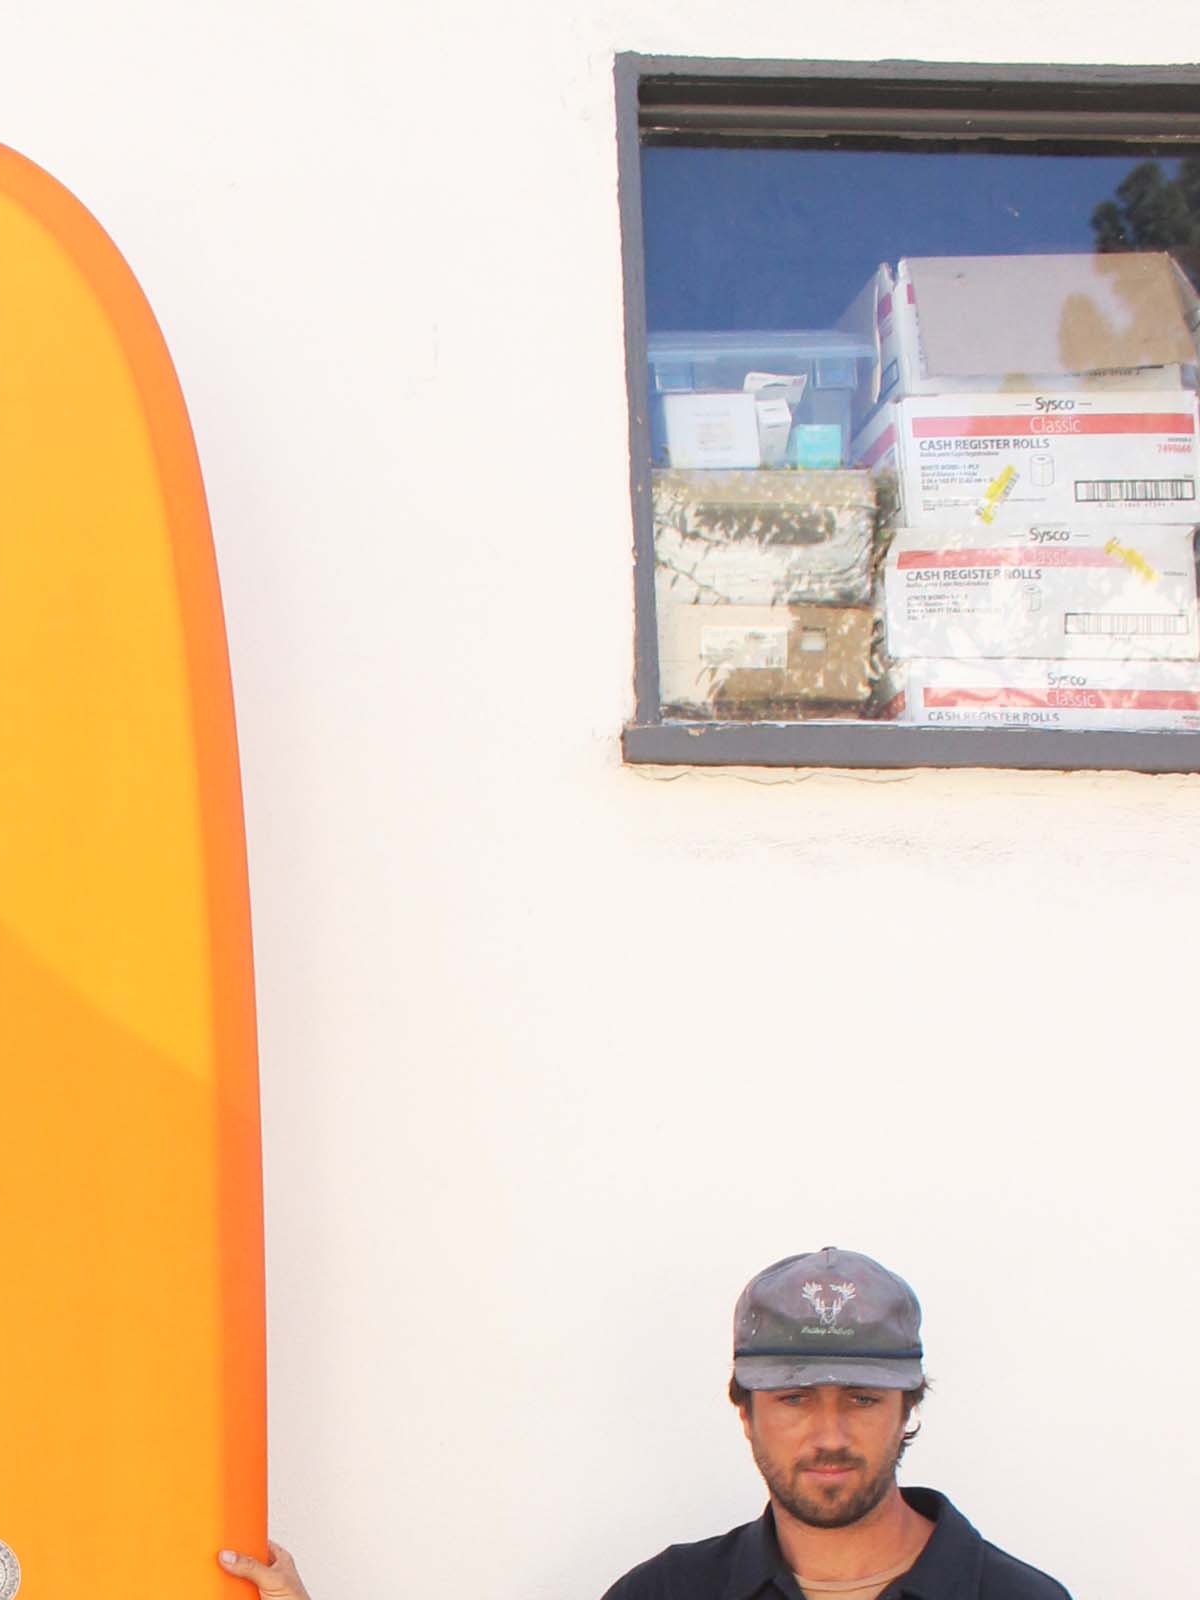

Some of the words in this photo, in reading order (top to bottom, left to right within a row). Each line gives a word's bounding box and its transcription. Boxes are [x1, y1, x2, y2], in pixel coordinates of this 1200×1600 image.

[1035, 397, 1074, 412] Sysco
[1030, 417, 1080, 433] Classic
[920, 440, 951, 451] CASH
[955, 439, 1010, 450] REGISTER
[1013, 439, 1050, 449] ROLLS
[1030, 528, 1070, 543] Sysco
[906, 571, 939, 582] CASH
[943, 569, 1001, 580] REGISTER
[1046, 691, 1096, 706] Classic
[928, 712, 961, 722] CASH
[1023, 712, 1060, 722] ROLLS
